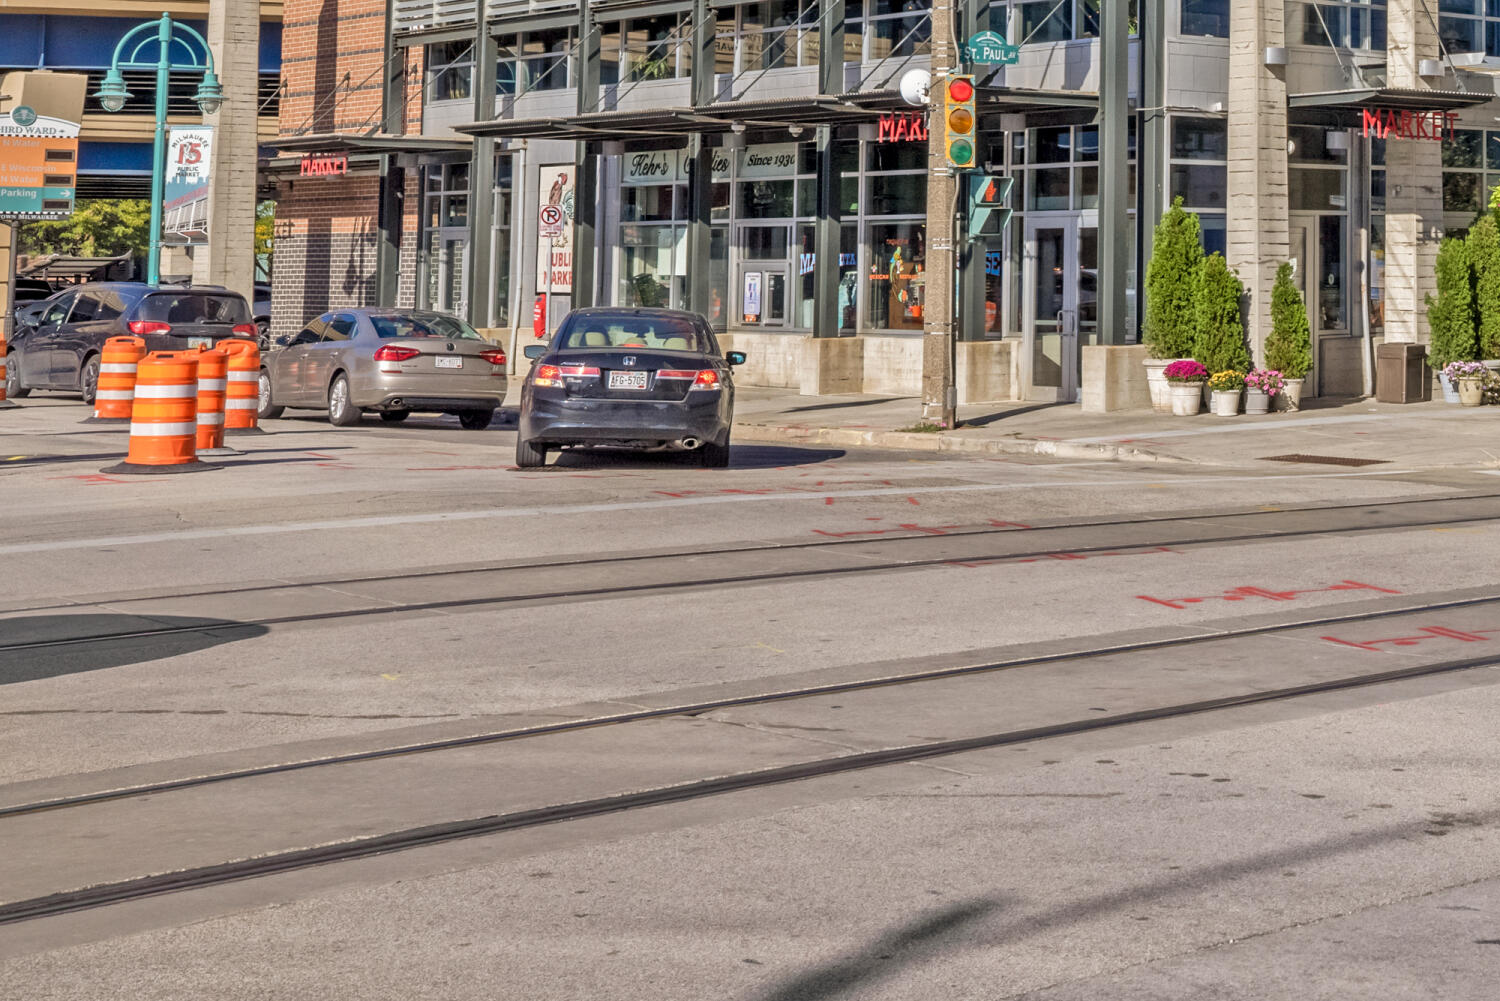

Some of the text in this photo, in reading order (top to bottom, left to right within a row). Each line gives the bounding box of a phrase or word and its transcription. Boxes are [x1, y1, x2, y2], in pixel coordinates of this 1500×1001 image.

[964, 46, 980, 60] ST.
[983, 46, 1008, 60] PAUL
[26, 127, 57, 135] WARD
[1363, 108, 1459, 141] MARKET
[177, 143, 202, 165] 15
[747, 153, 772, 167] Since
[300, 156, 347, 176] MARKET
[1, 188, 37, 200] Parking
